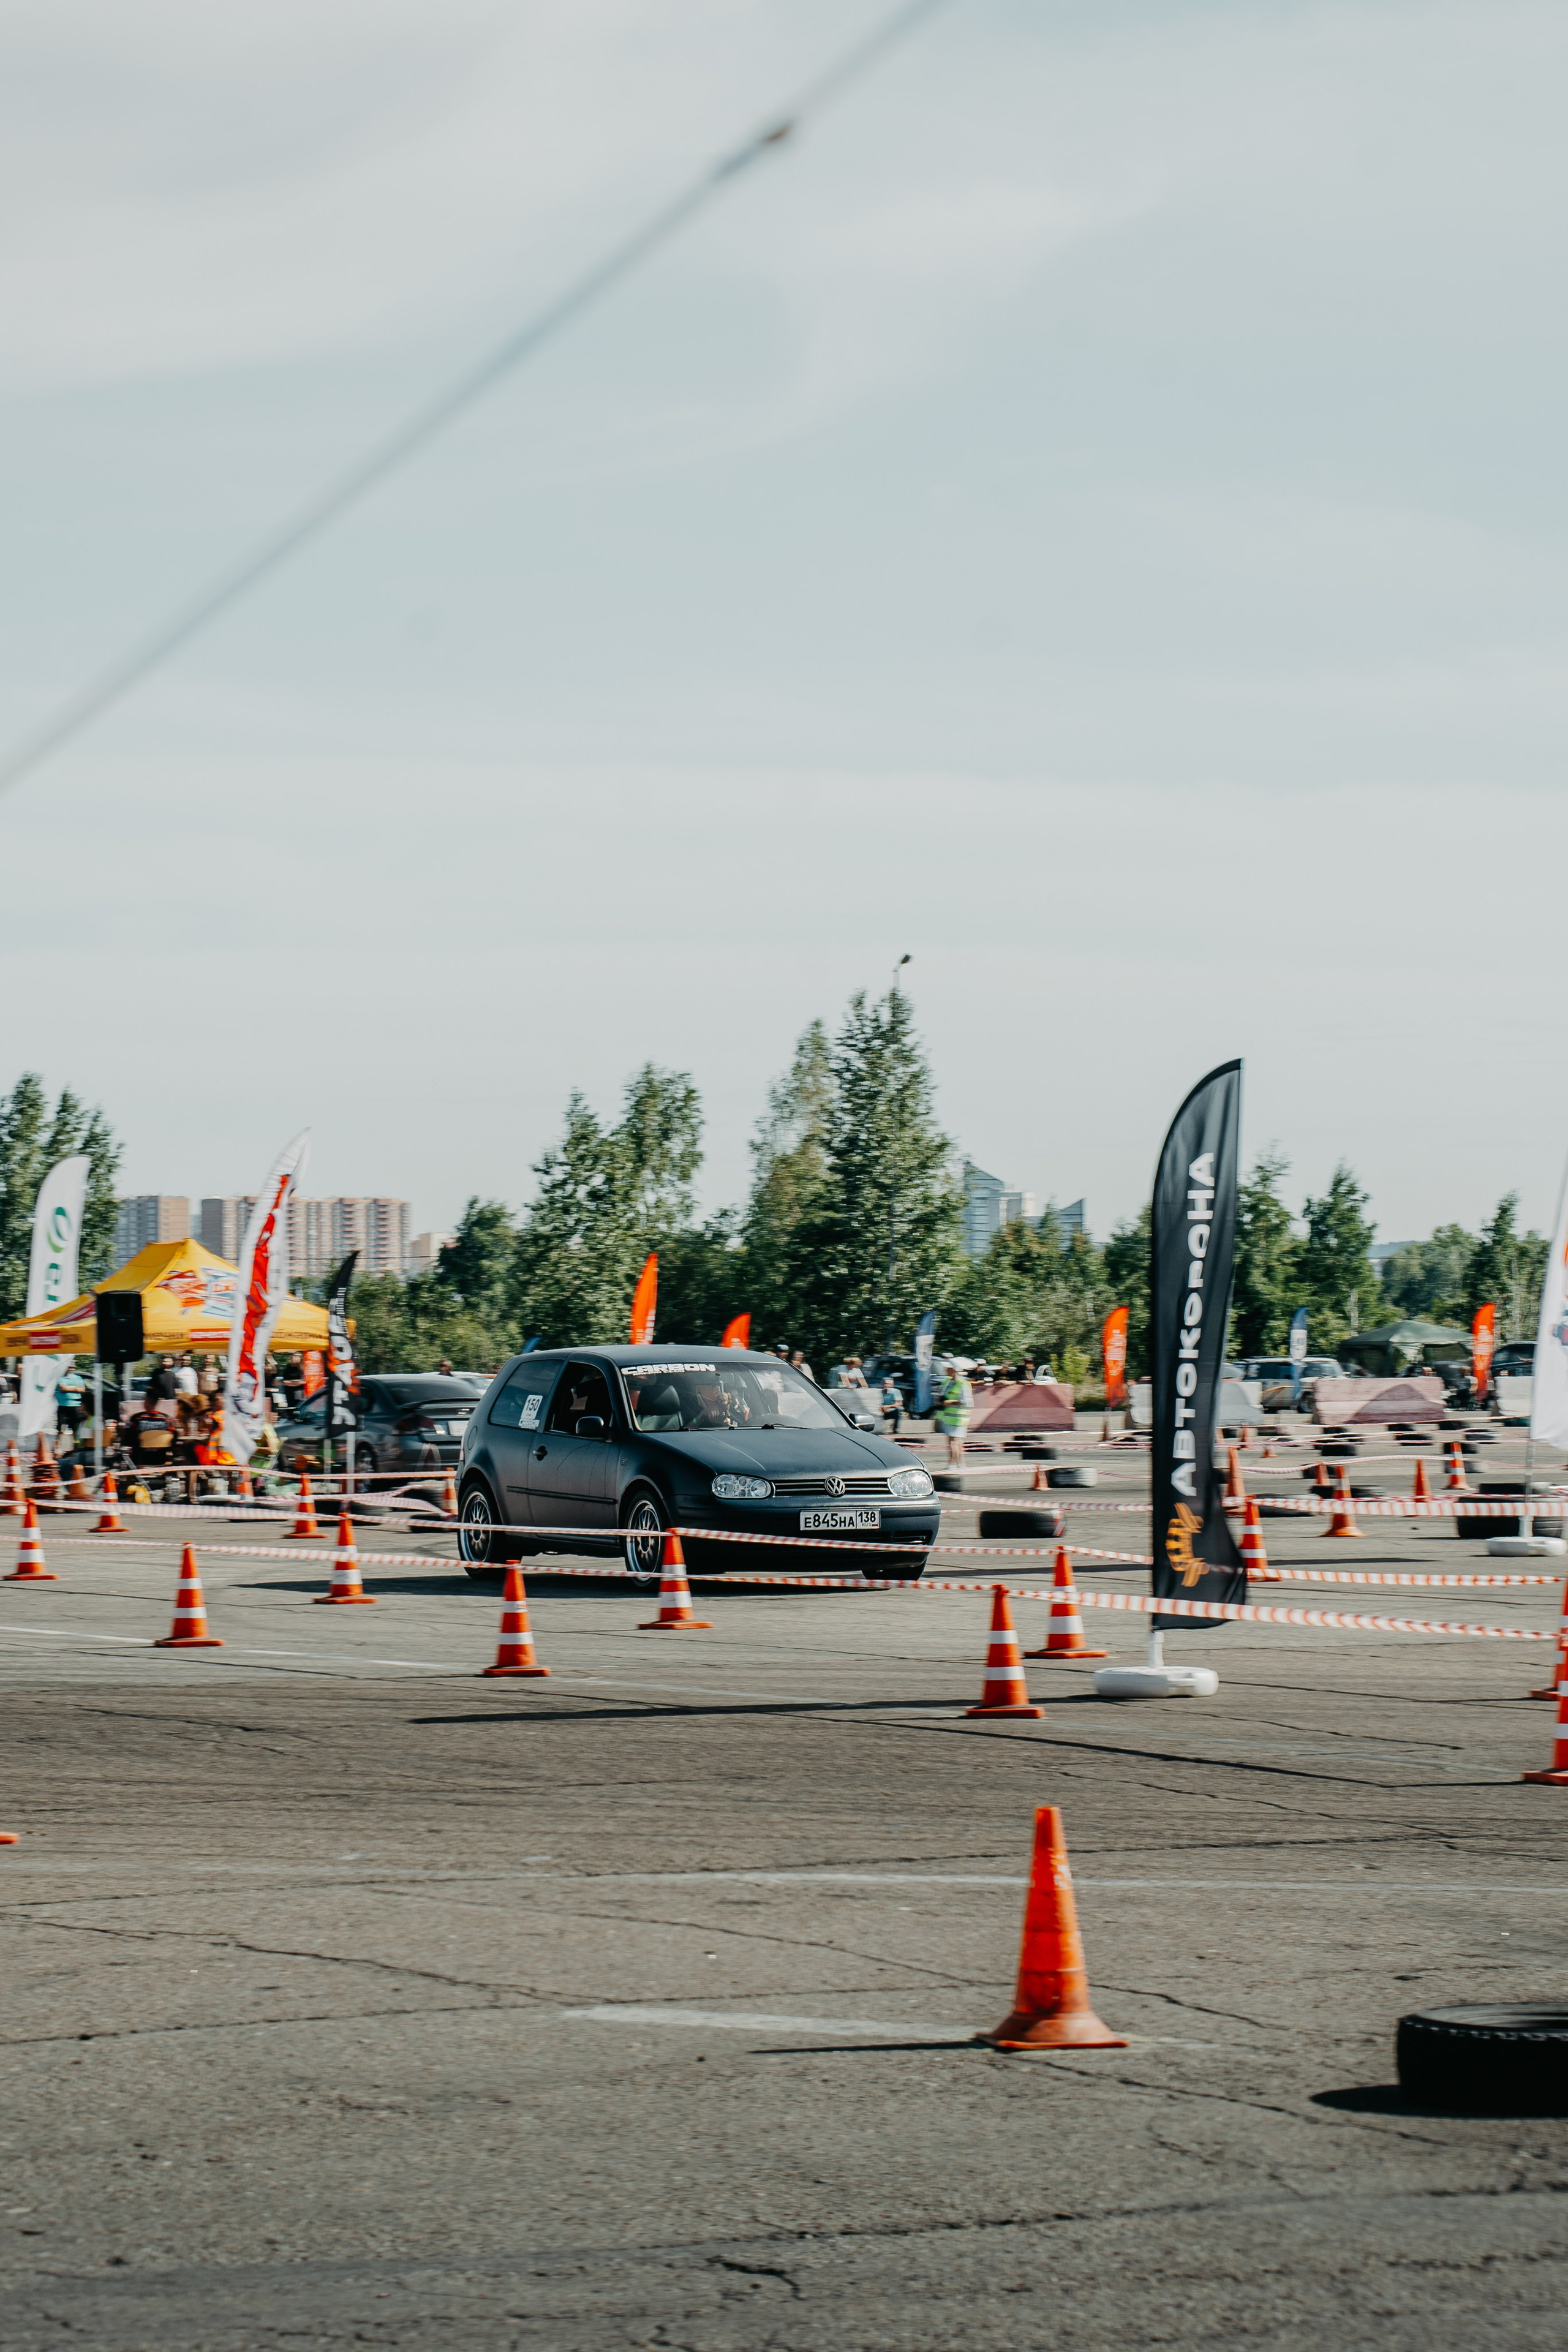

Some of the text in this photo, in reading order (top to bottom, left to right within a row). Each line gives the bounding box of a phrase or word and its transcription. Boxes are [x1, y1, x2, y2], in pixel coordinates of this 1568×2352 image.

[1171, 1152, 1215, 1496] АВТОКОРОНА
[621, 1363, 716, 1375] CARBON
[526, 1398, 540, 1411] 150
[858, 1512, 876, 1523] 138
